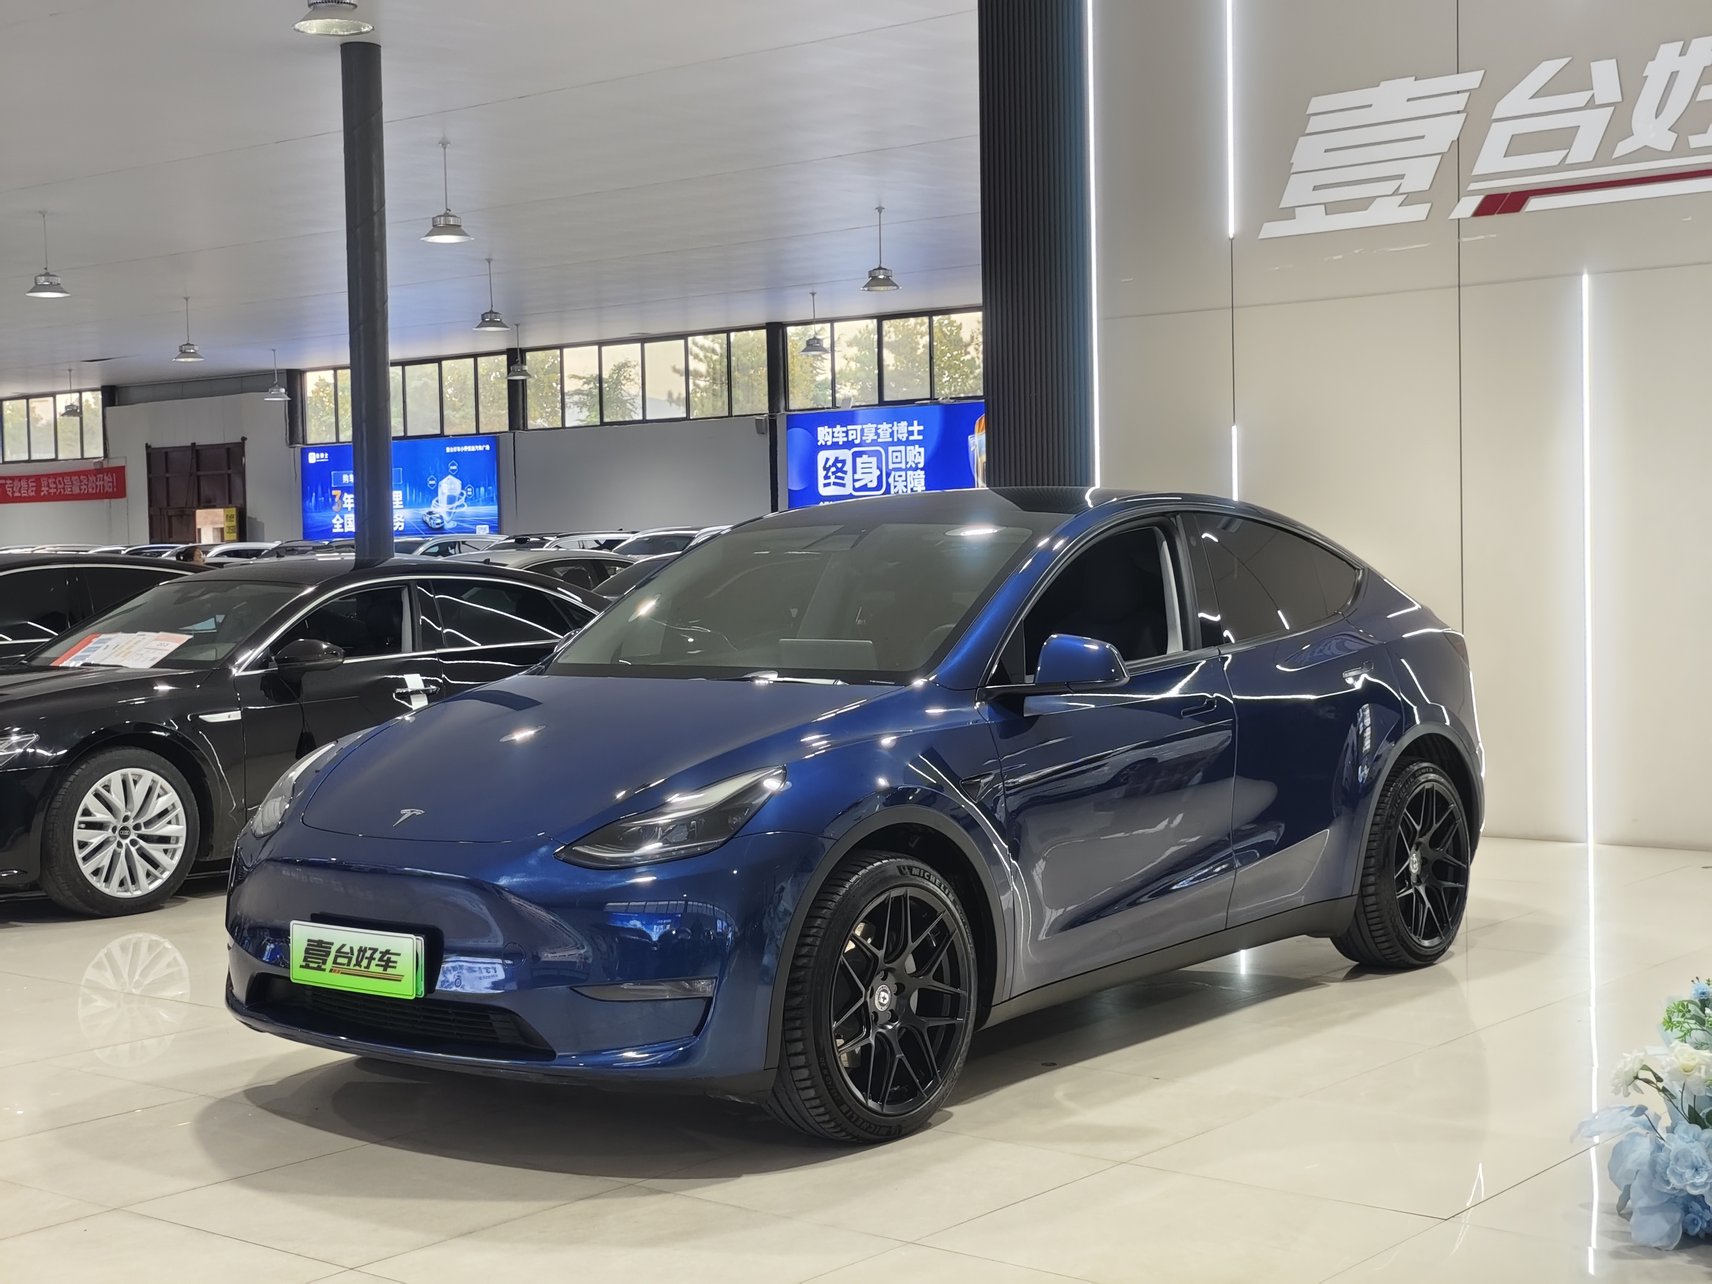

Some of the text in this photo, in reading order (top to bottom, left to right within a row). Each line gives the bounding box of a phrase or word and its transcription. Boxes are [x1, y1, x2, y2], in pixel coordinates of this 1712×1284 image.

[817, 421, 924, 445] 购车可享查博士
[822, 453, 881, 489] 终身
[888, 445, 925, 469] 回购
[888, 470, 926, 494] 保障
[911, 866, 955, 902] MICHELIN
[299, 938, 402, 972] 壹台好车
